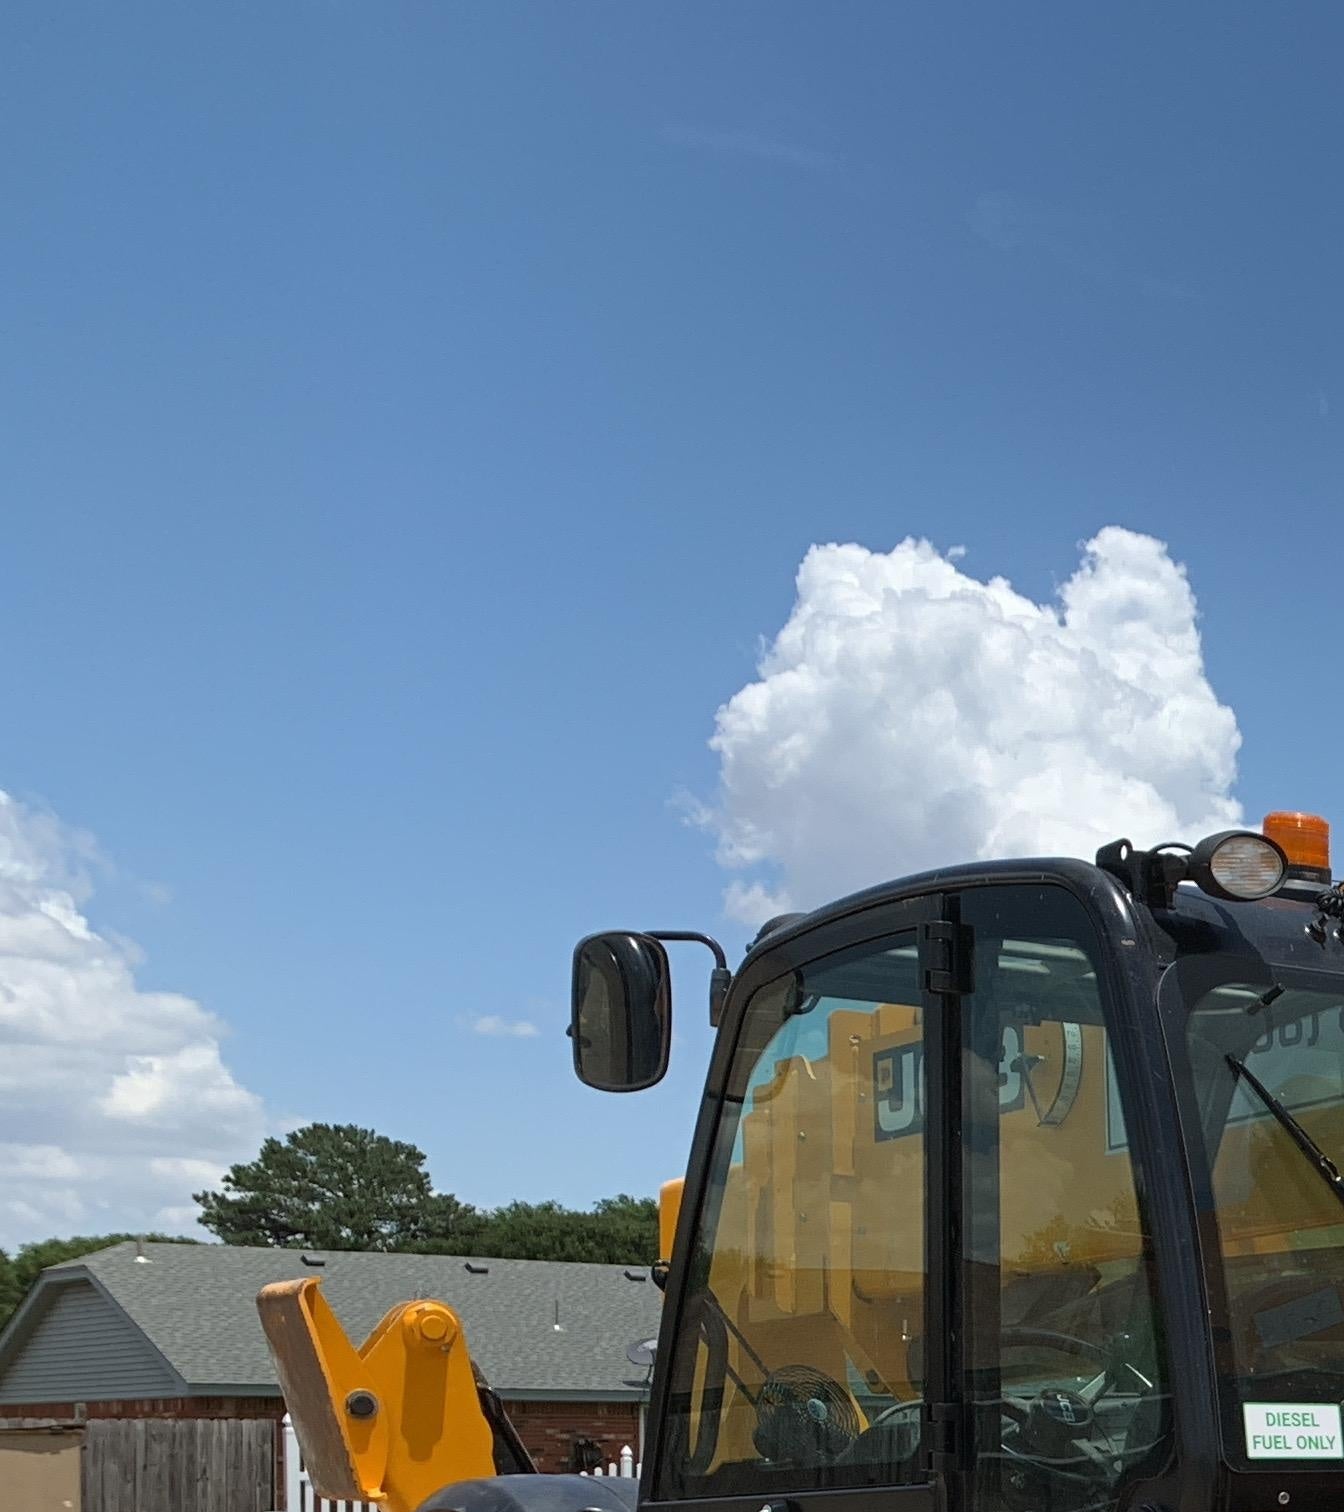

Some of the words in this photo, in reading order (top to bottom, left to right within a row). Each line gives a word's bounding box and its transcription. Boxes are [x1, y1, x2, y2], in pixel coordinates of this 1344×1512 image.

[1265, 1412, 1320, 1427] DIESEL
[1252, 1435, 1293, 1450] FUEL
[1296, 1435, 1336, 1450] ONLY
